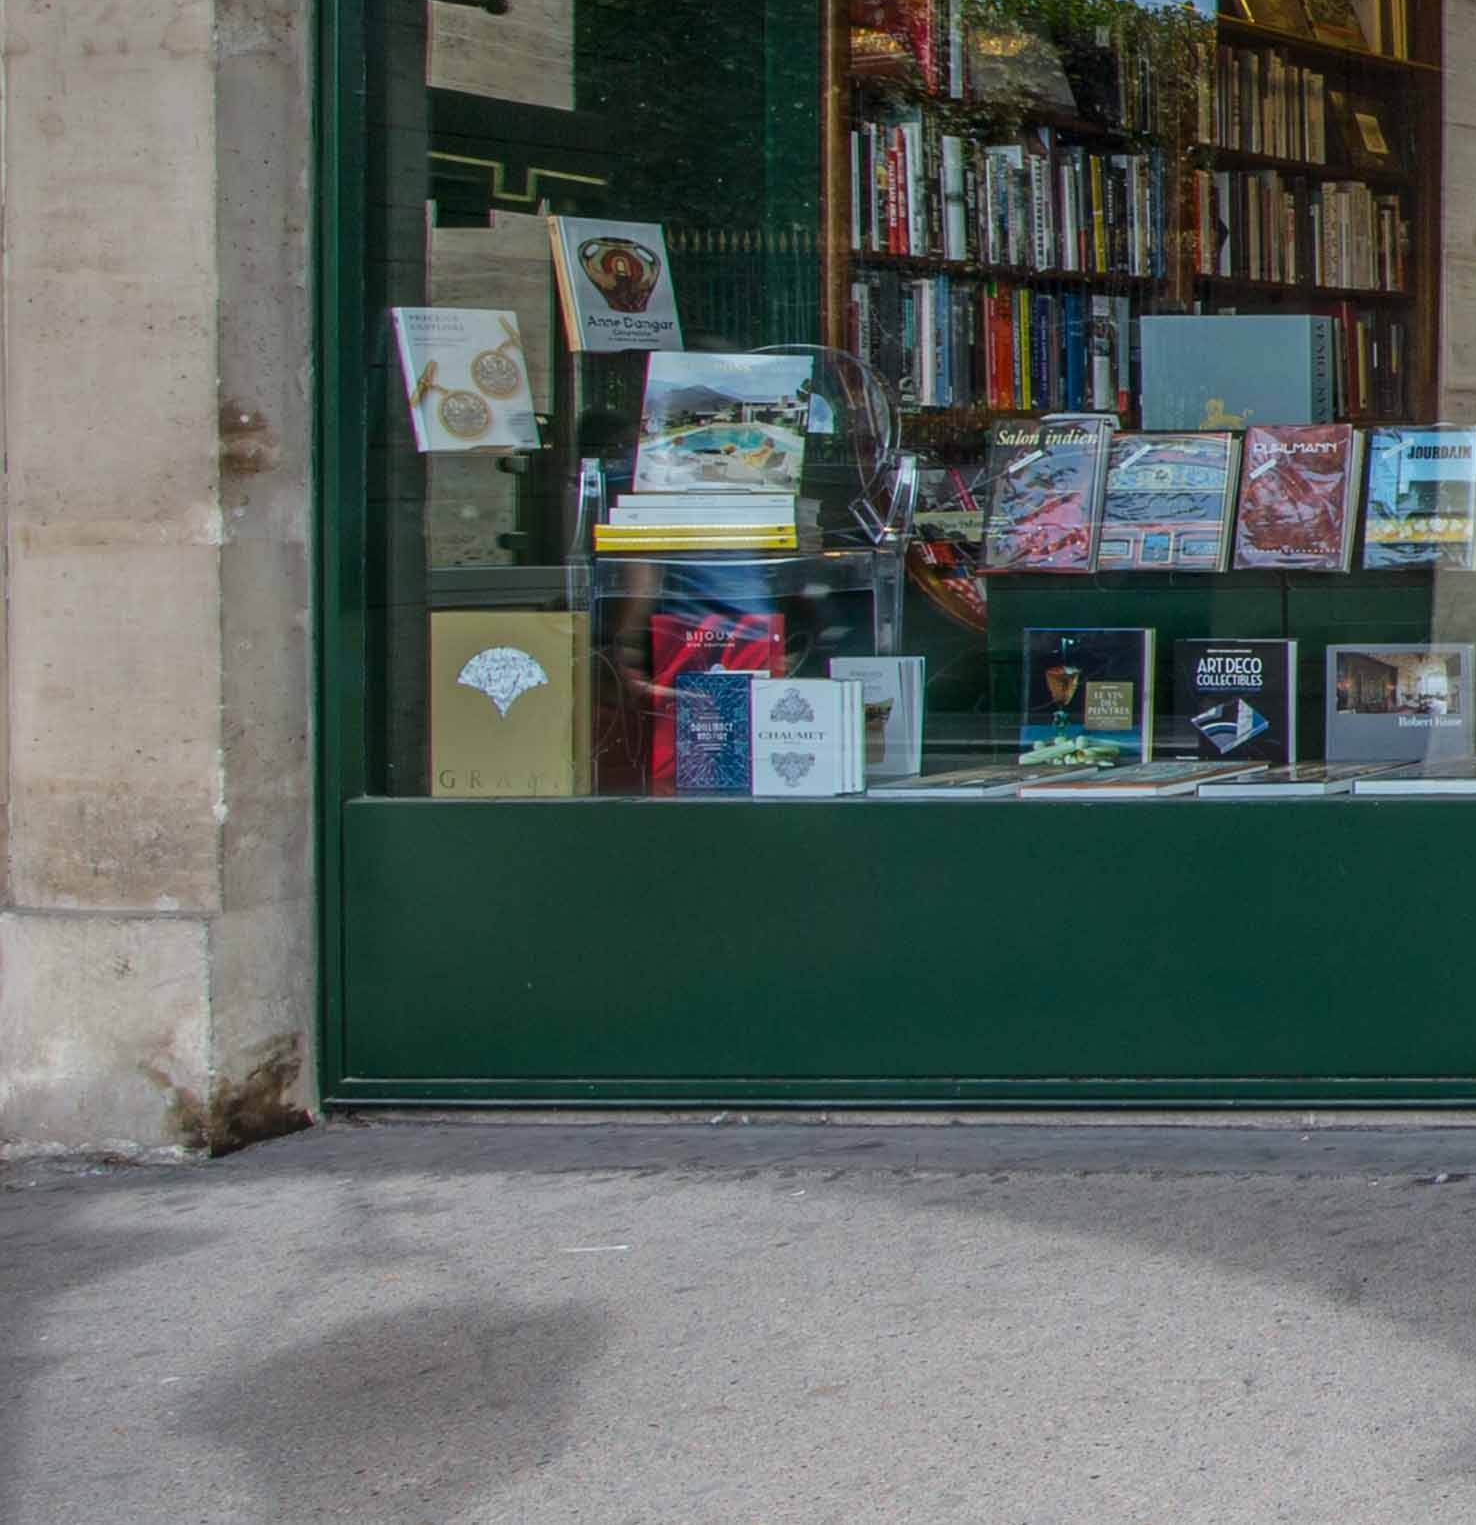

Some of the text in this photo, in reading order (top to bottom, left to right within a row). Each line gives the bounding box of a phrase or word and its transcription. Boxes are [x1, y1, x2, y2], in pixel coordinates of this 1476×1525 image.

[588, 315, 674, 332] Anne Dangar
[996, 428, 1099, 446] Salon indien
[1252, 441, 1338, 455] RUHLMANN
[686, 631, 736, 642] BIJOUX
[1197, 657, 1262, 674] ART DECO
[1196, 674, 1263, 687] COLLECTIBLES
[1398, 715, 1432, 727] Robert
[758, 730, 827, 741] CHAUMET
